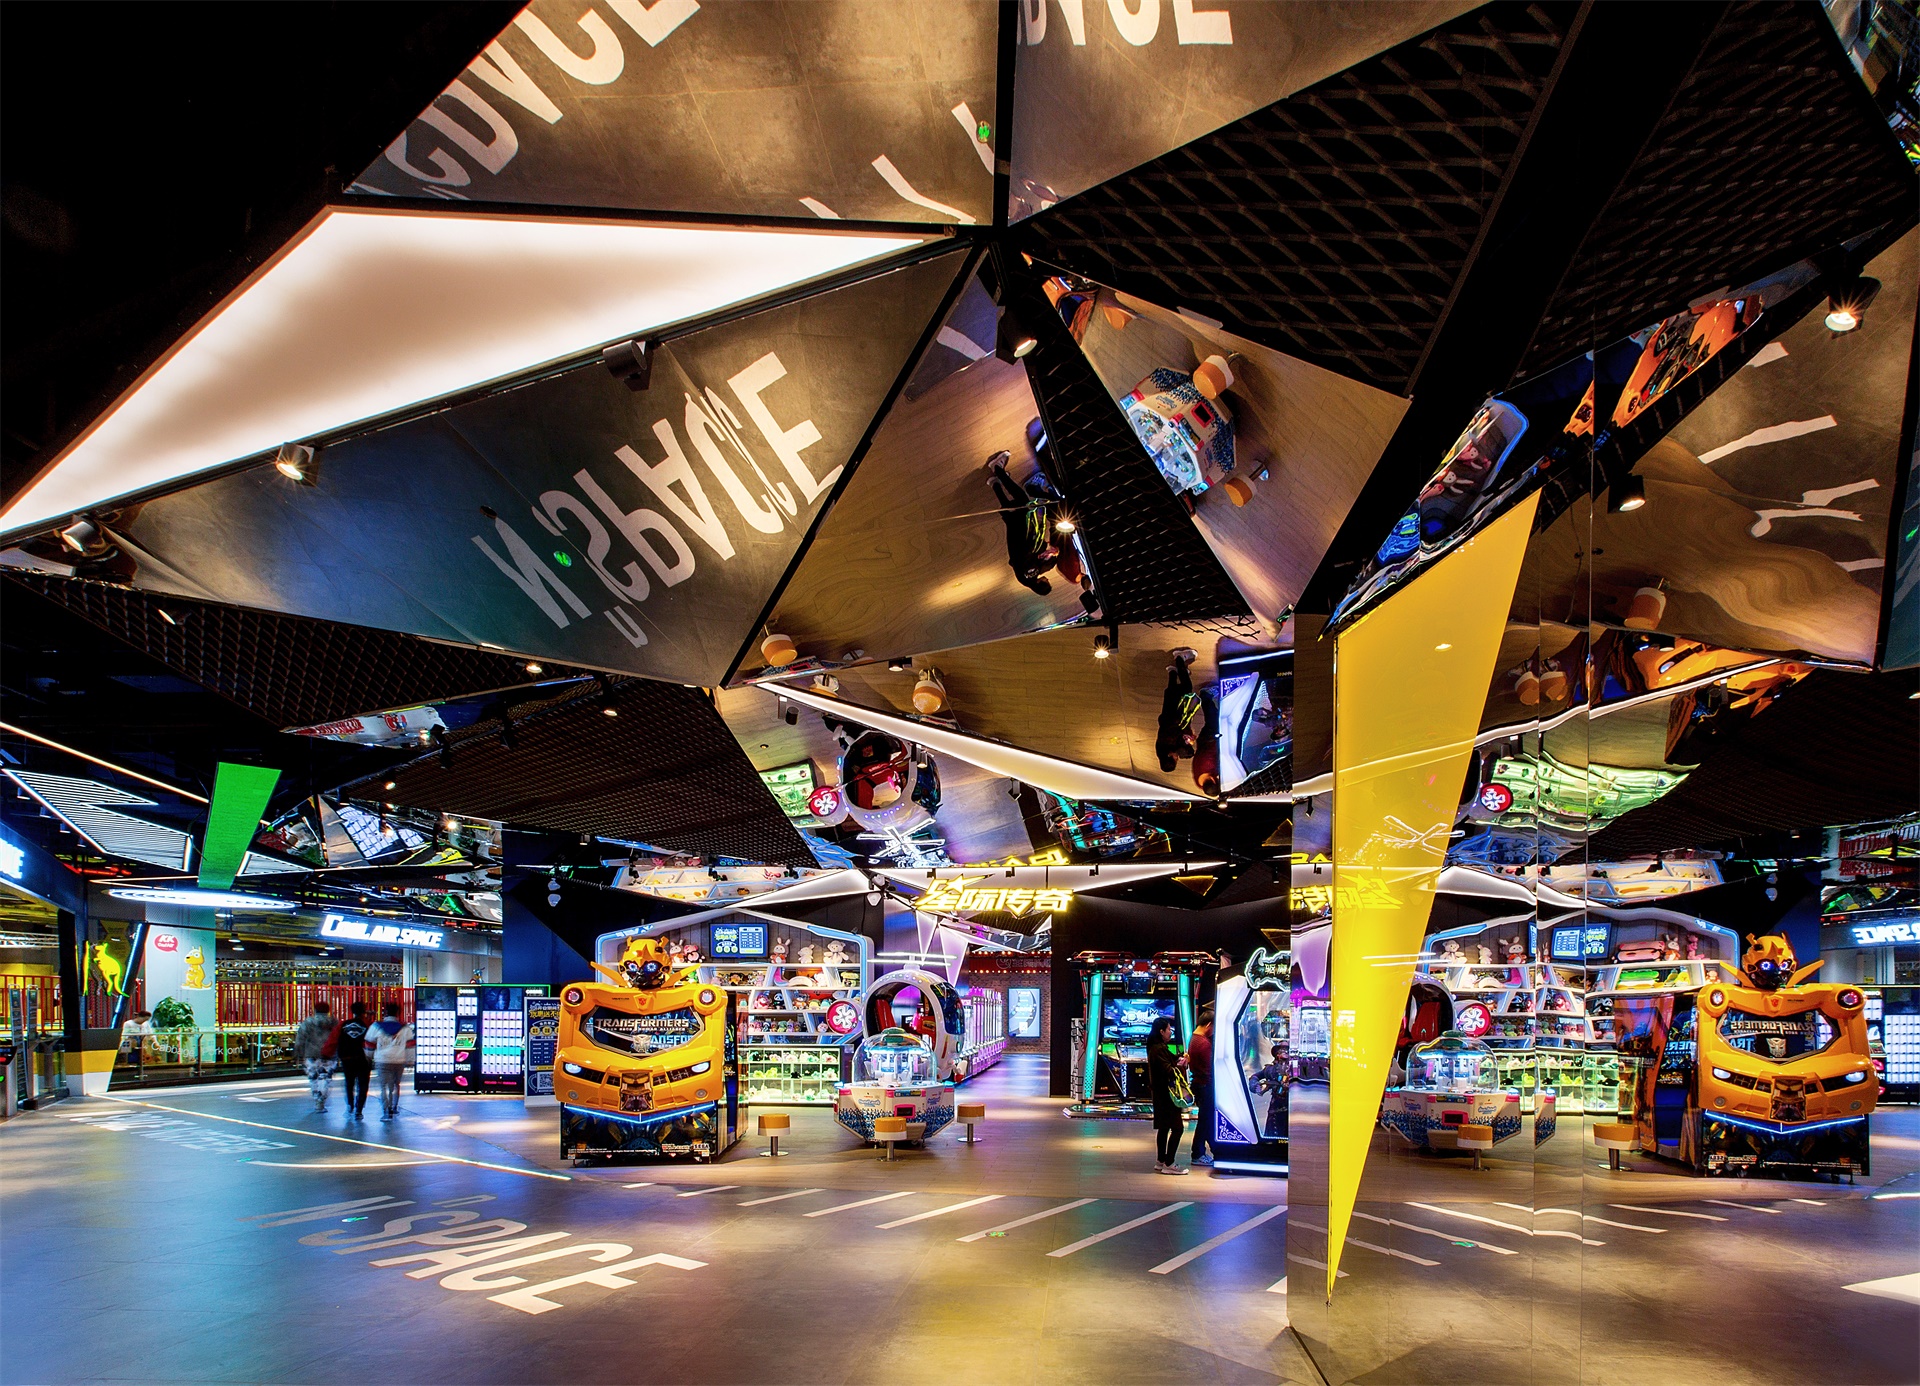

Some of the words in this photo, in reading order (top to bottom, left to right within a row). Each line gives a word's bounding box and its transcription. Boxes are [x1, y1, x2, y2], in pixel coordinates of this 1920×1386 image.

[915, 873, 1074, 917] 星际传奇
[158, 934, 175, 943] KK
[398, 928, 443, 948] SPACE
[595, 1018, 689, 1031] TRANSFORMERS
[262, 1046, 284, 1058] Drink
[298, 1210, 709, 1315] SPACE
